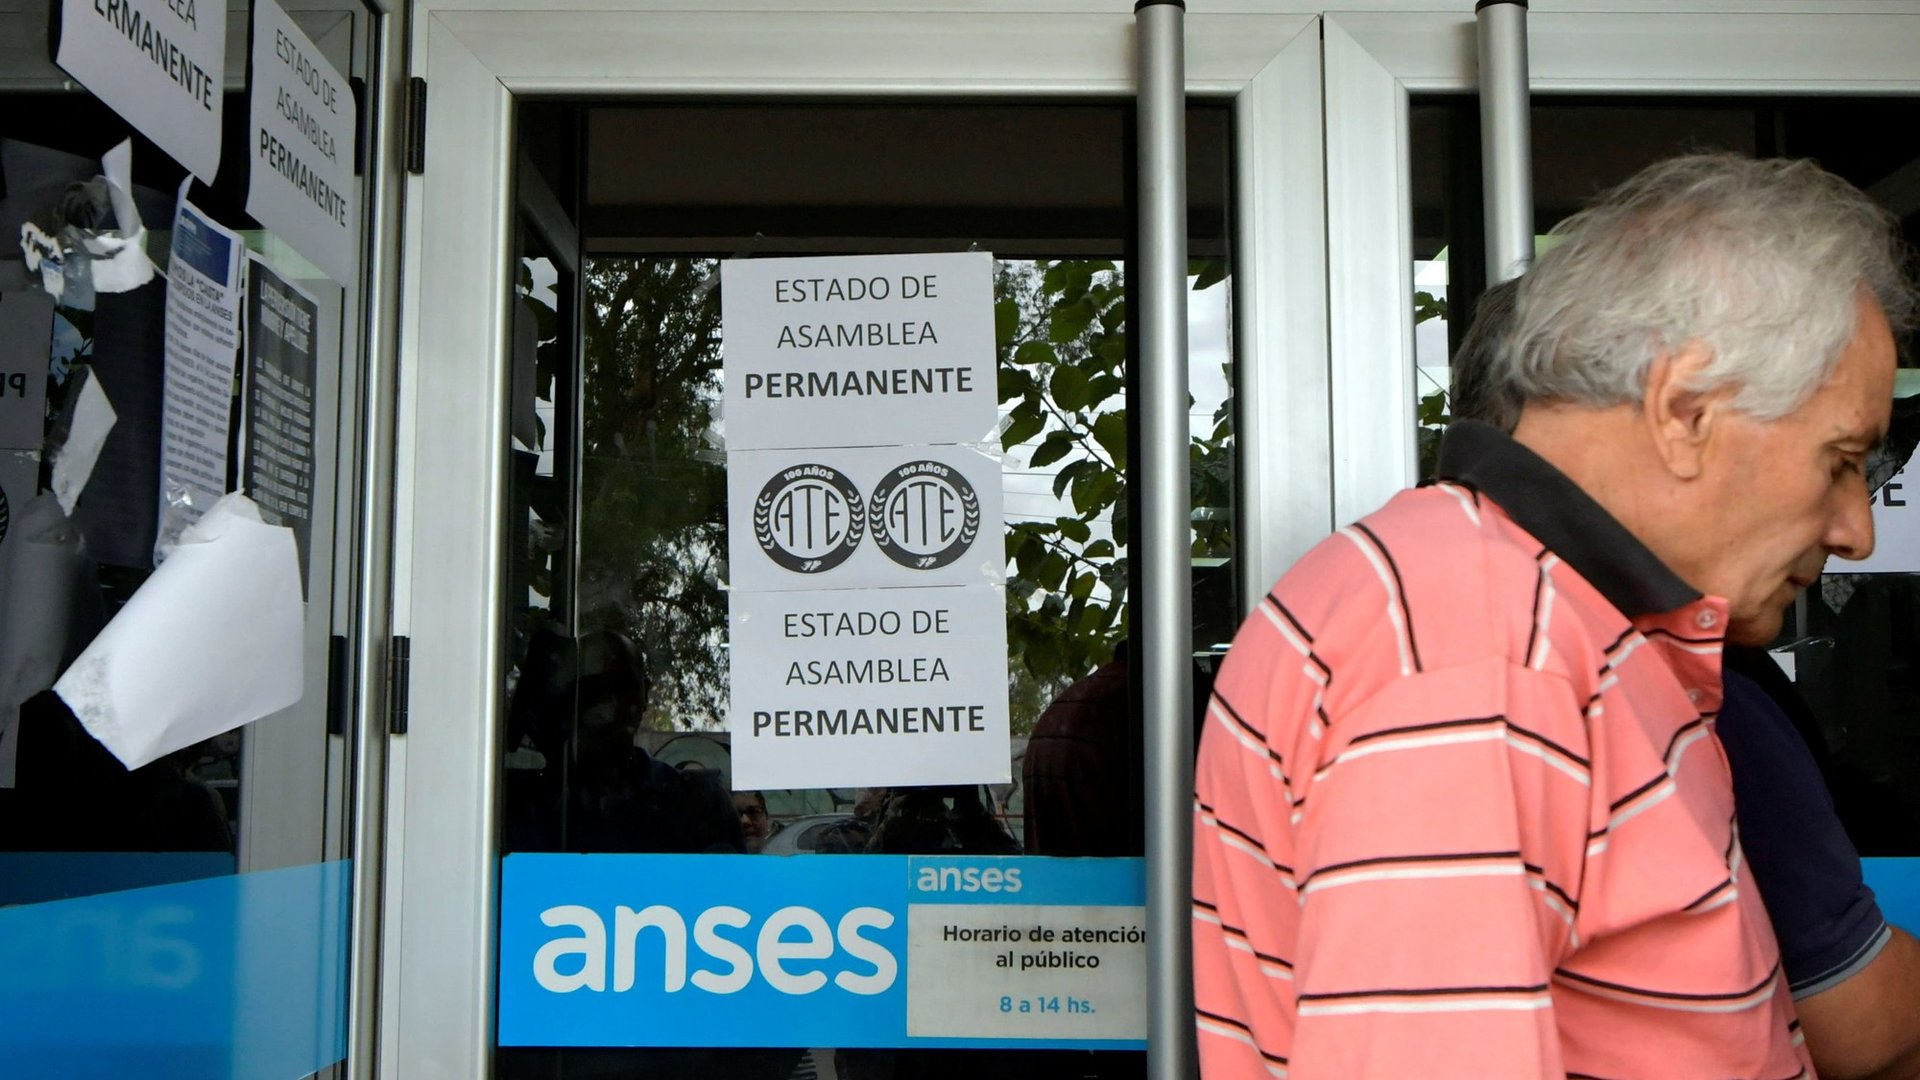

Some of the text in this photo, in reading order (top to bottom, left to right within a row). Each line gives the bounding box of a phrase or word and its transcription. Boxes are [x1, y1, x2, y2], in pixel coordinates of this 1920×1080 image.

[94, 0, 213, 112] RMANENTE
[276, 28, 337, 115] ESTADO DE
[276, 86, 337, 166] ASAMBLEA
[260, 127, 346, 228] PERMANENTE
[775, 275, 938, 303] ESTADO DE
[777, 321, 938, 349] ASAMBLEA
[745, 367, 973, 399] PERMANENTE
[783, 466, 834, 481] 100 AÑOS
[898, 462, 949, 478] 100 AÑOS
[775, 484, 840, 549] ATE
[889, 481, 955, 546] ATE
[784, 609, 949, 638] ESTADO DE
[786, 657, 950, 686] ASAMBLEA
[753, 706, 985, 737] PERMANENTE
[917, 866, 1022, 893] anses
[943, 925, 1022, 943] Horario
[1029, 925, 1055, 943] de
[533, 905, 898, 995] anses
[996, 951, 1100, 971] al público
[1000, 996, 1096, 1014] 8 a 14 hs.
